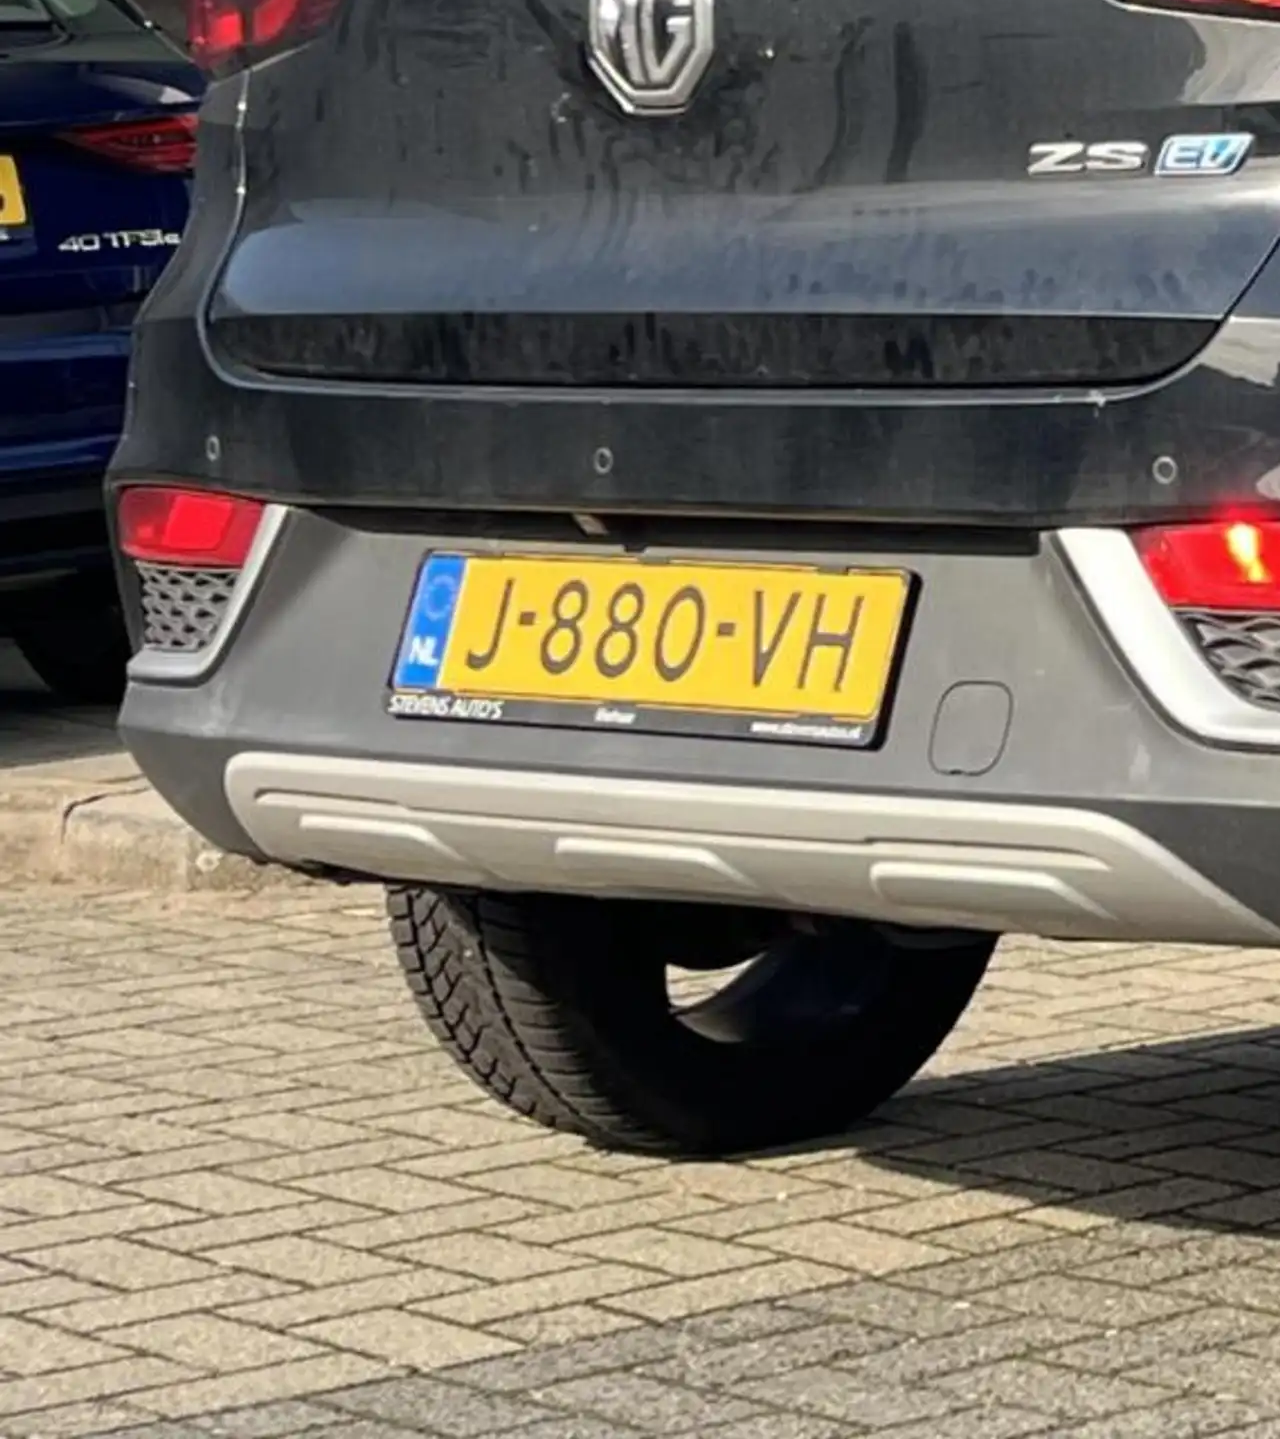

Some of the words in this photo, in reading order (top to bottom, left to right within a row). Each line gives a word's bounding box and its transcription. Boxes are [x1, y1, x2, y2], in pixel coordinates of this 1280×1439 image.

[1027, 141, 1149, 175] ZS
[57, 233, 101, 252] 40
[408, 636, 438, 666] NL
[464, 577, 866, 693] J-880-VH
